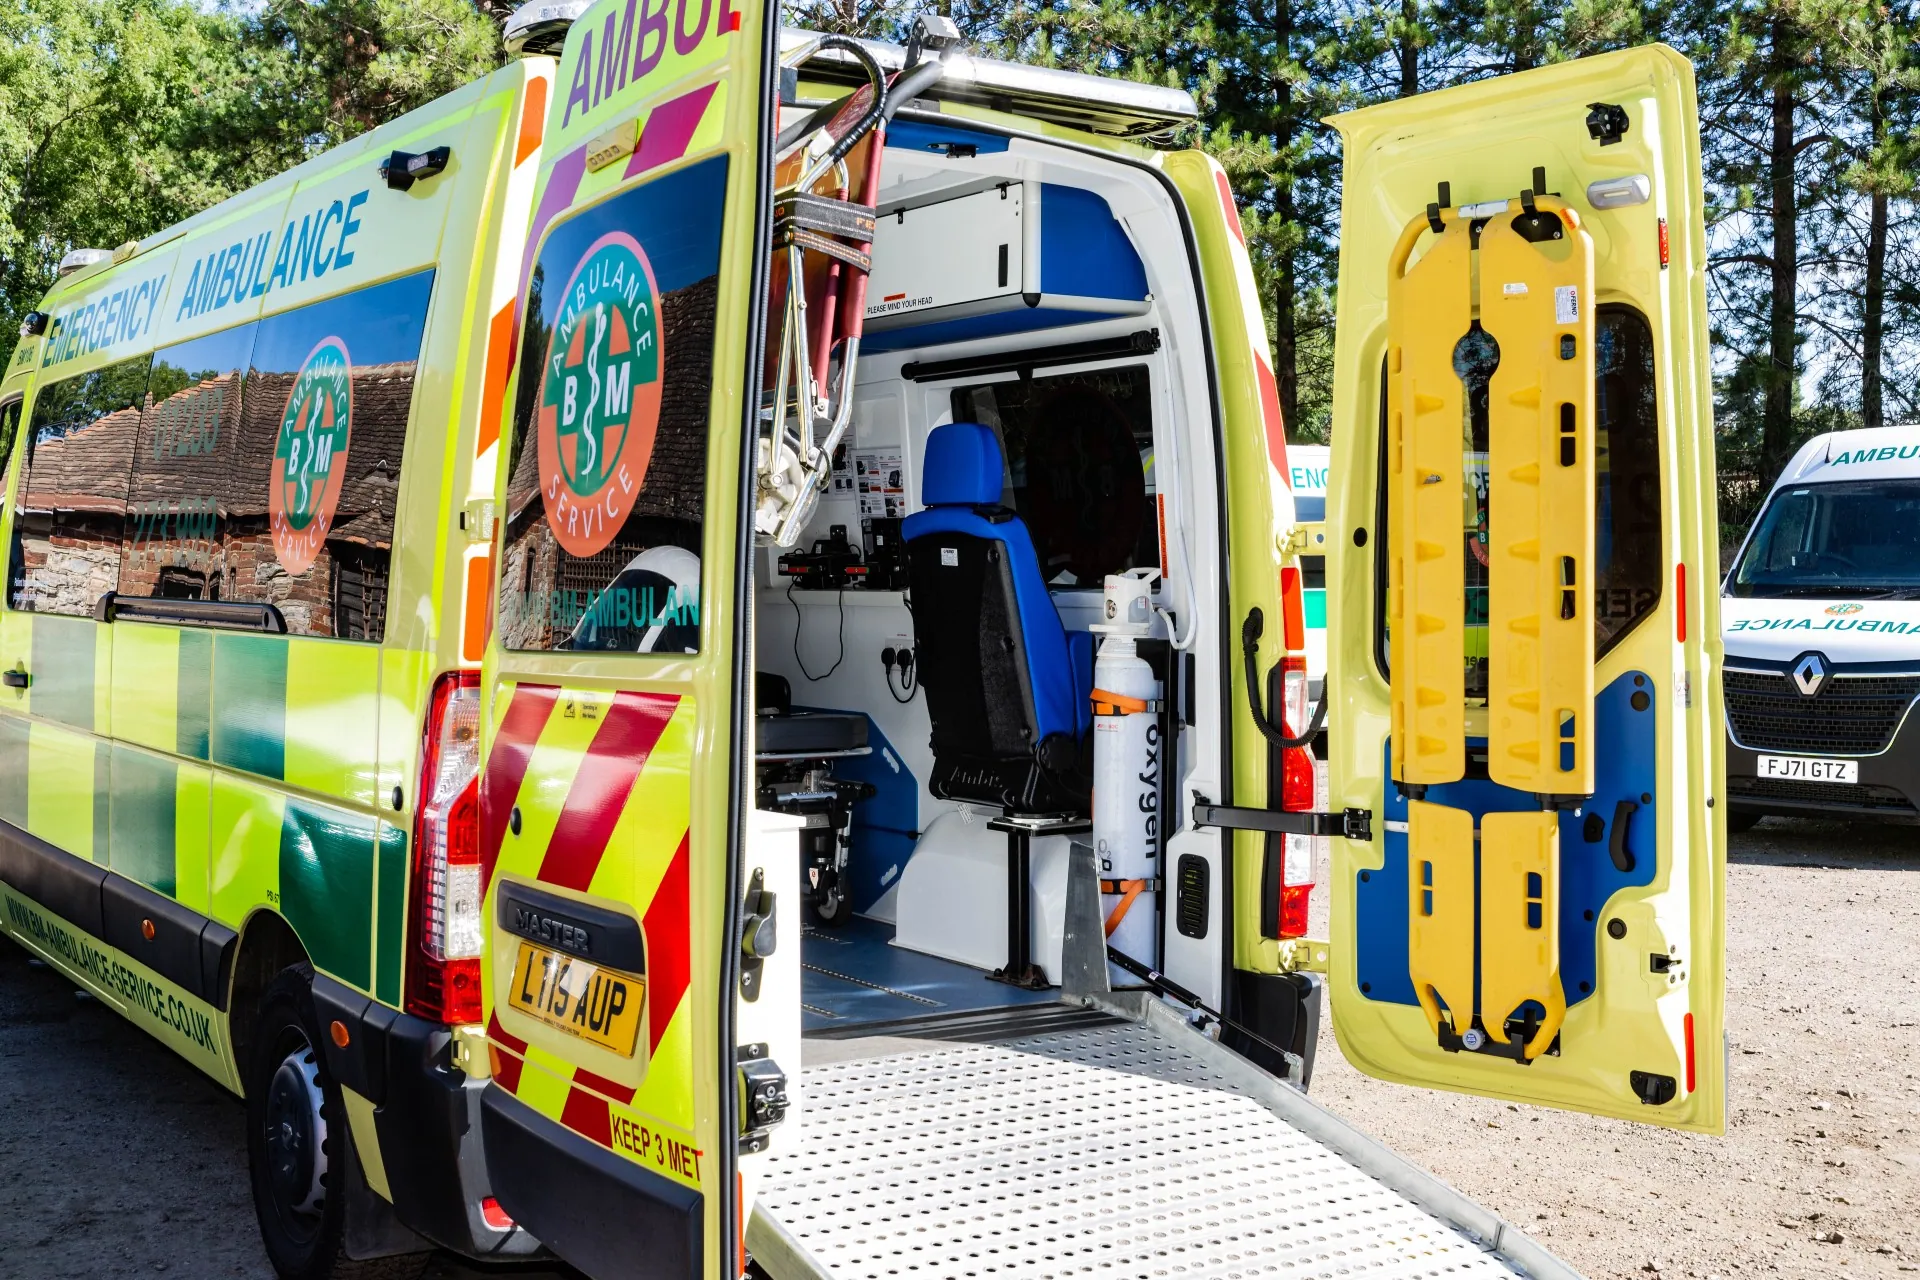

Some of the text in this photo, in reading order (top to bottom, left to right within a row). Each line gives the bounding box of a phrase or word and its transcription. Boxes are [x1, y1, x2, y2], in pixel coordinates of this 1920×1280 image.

[42, 189, 370, 368] EMERGENCY AMBULANCE
[867, 296, 933, 315] PLEASE MIND YOUR HEAD
[1570, 295, 1578, 316] FERNO
[552, 258, 652, 378] AMBULANCE
[285, 355, 347, 439] AMBULANCE
[274, 508, 326, 561] SERVICE
[549, 463, 633, 539] SERVICE
[1139, 723, 1158, 859] oxygen
[1768, 759, 1846, 780] FJ71 GTZ
[514, 907, 590, 951] MASTER
[5, 893, 217, 1055] WWW.BM-AMBULANCE-SERVICE.CO.UK
[611, 1113, 703, 1182] KEEP 3 MET
